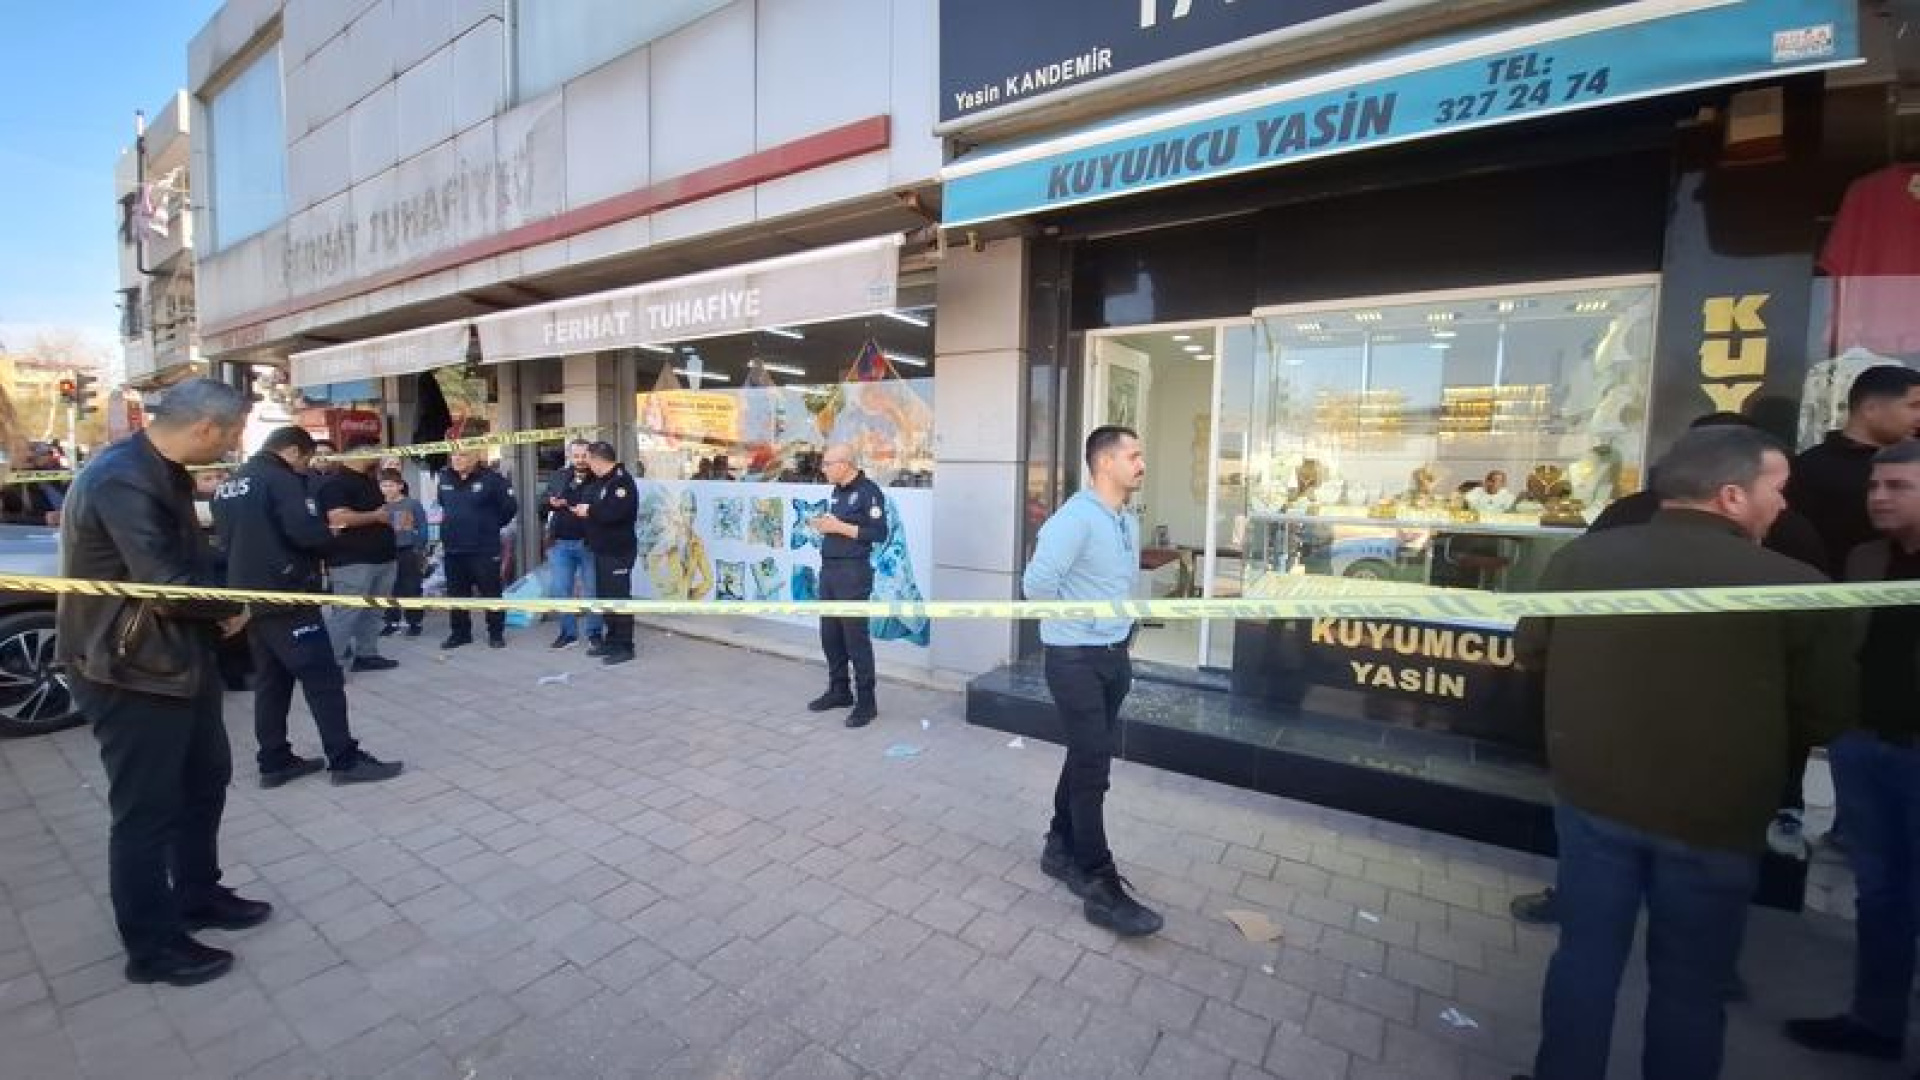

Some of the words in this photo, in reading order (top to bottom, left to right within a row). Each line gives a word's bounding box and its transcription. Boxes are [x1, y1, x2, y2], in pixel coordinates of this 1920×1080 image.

[955, 84, 1001, 112] Yasin
[1006, 46, 1115, 98] KANDEMİR
[1433, 90, 1498, 124] 327
[1506, 79, 1553, 111] 24
[1563, 66, 1611, 101] 74
[1486, 52, 1556, 85] TEL:
[1047, 126, 1240, 200] KUYUMCU
[1256, 91, 1399, 157] YASİN
[543, 310, 632, 347] FERHAT
[647, 287, 762, 331] TUHAFİYE
[1311, 617, 1515, 668] KUYUMCU
[1349, 660, 1467, 699] YASİN
